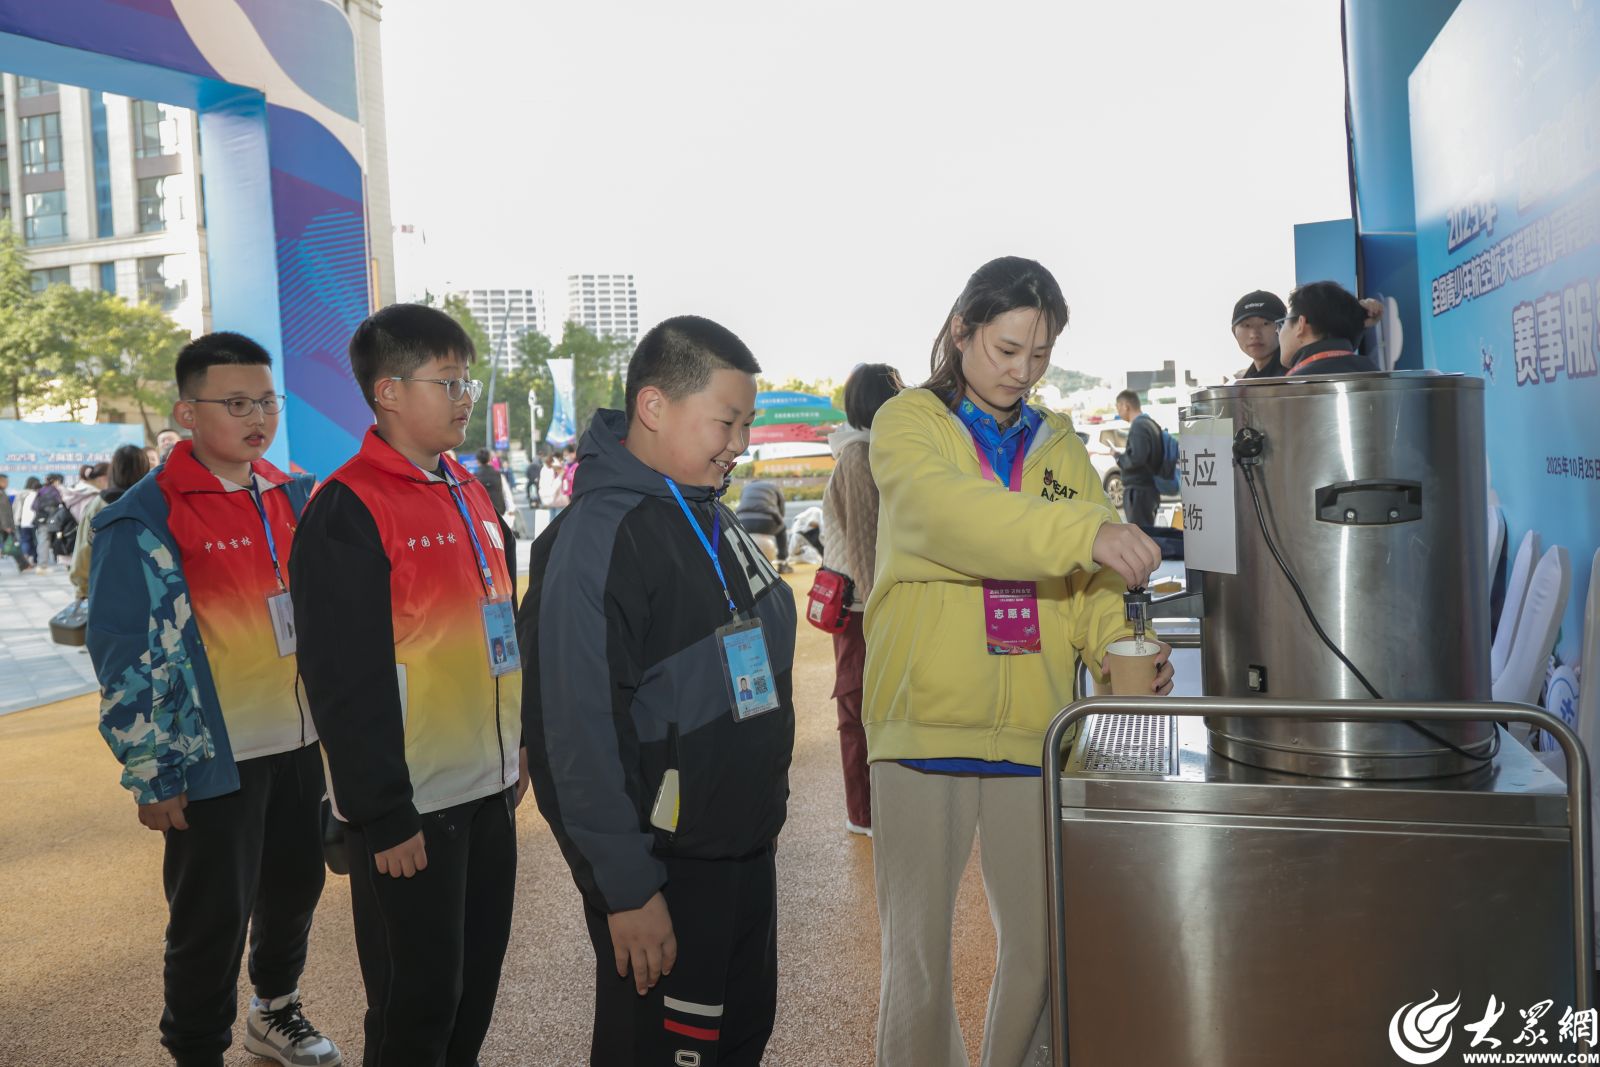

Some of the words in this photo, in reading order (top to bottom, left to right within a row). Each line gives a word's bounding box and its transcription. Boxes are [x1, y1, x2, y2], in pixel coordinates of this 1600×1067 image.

[1513, 277, 1600, 386] 赛事服
[1546, 456, 1600, 480] 2025年10月25日
[204, 536, 252, 553] 中国吉林
[407, 532, 457, 551] 中国吉林
[994, 608, 1031, 619] 志愿者
